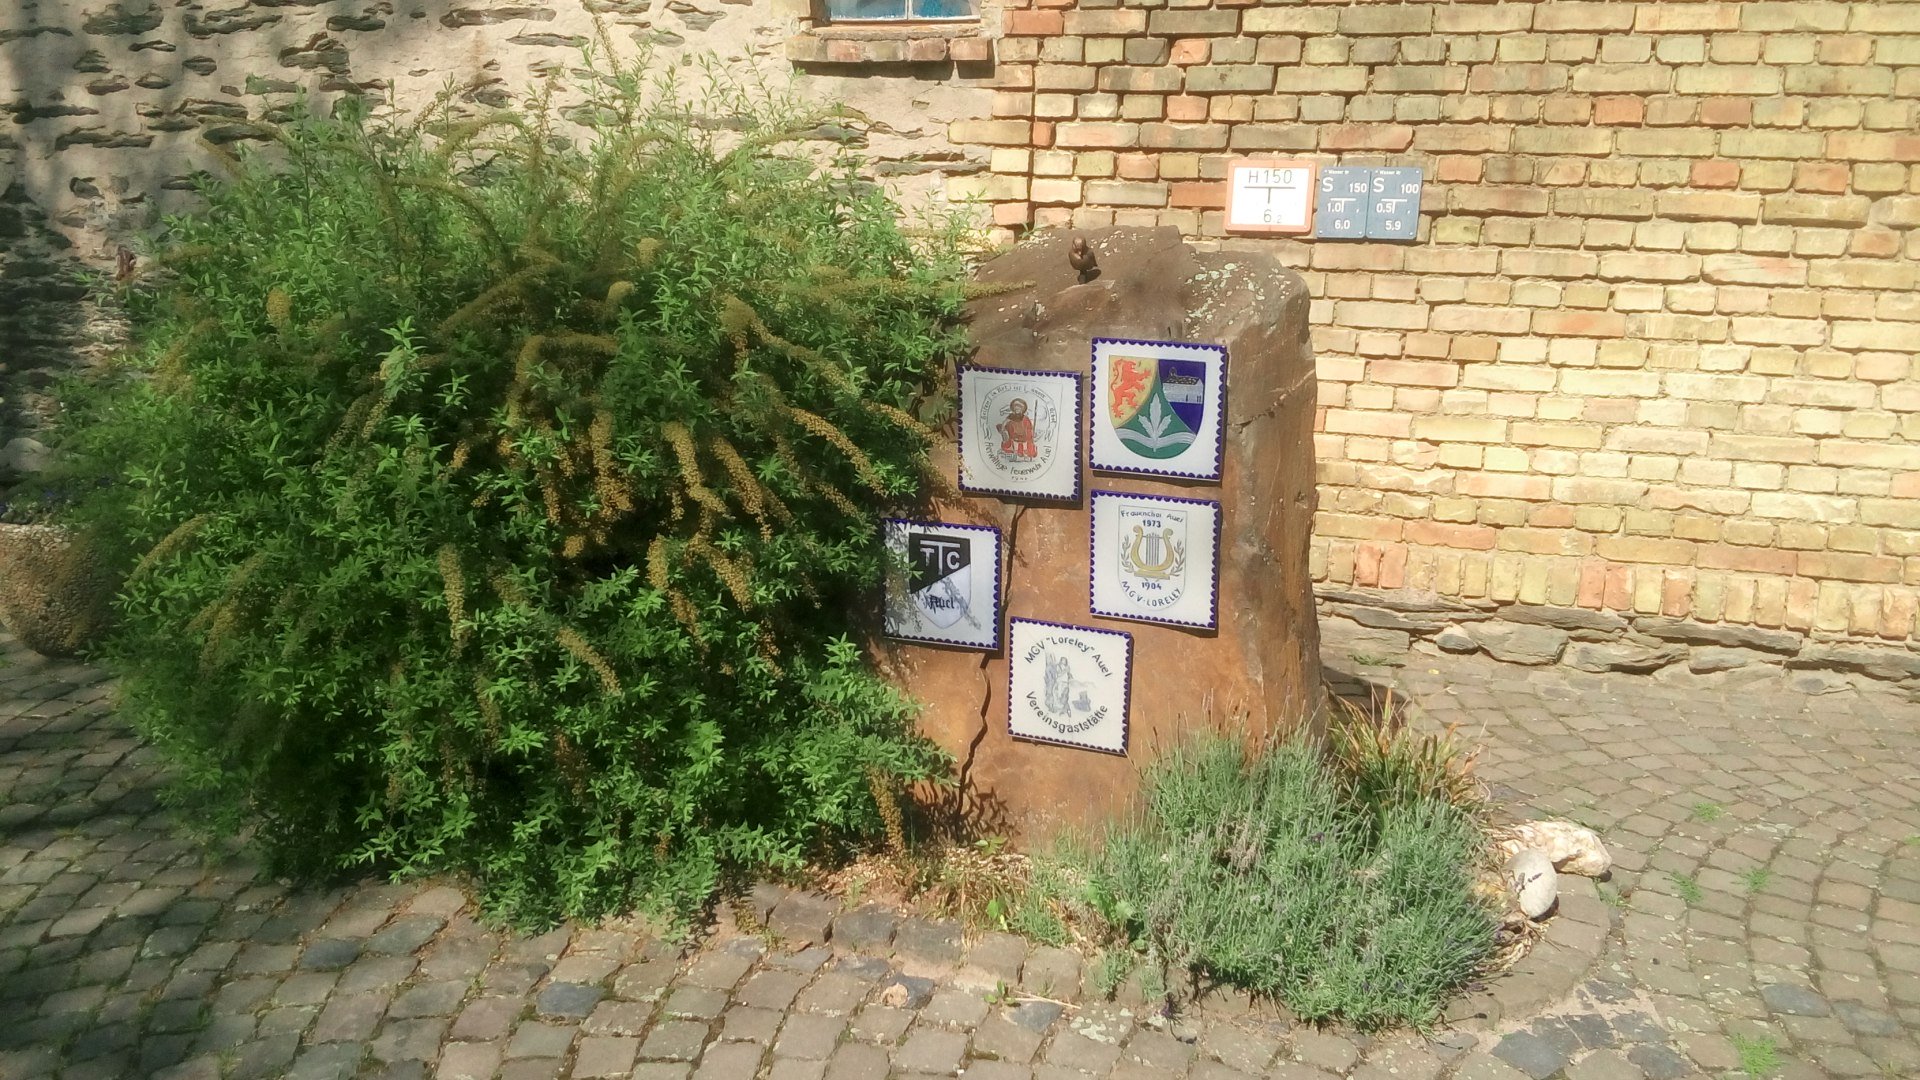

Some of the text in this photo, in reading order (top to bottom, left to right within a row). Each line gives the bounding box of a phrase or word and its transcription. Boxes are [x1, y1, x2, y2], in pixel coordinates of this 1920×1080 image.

[1322, 177, 1367, 194] S 150
[1373, 177, 1419, 194] S 100
[1142, 519, 1162, 528] 1973
[1141, 581, 1162, 590] 1904
[1024, 640, 1046, 664] MGV
[1092, 653, 1113, 677] Auel
[1026, 691, 1108, 734] Vereinsgaststätte
